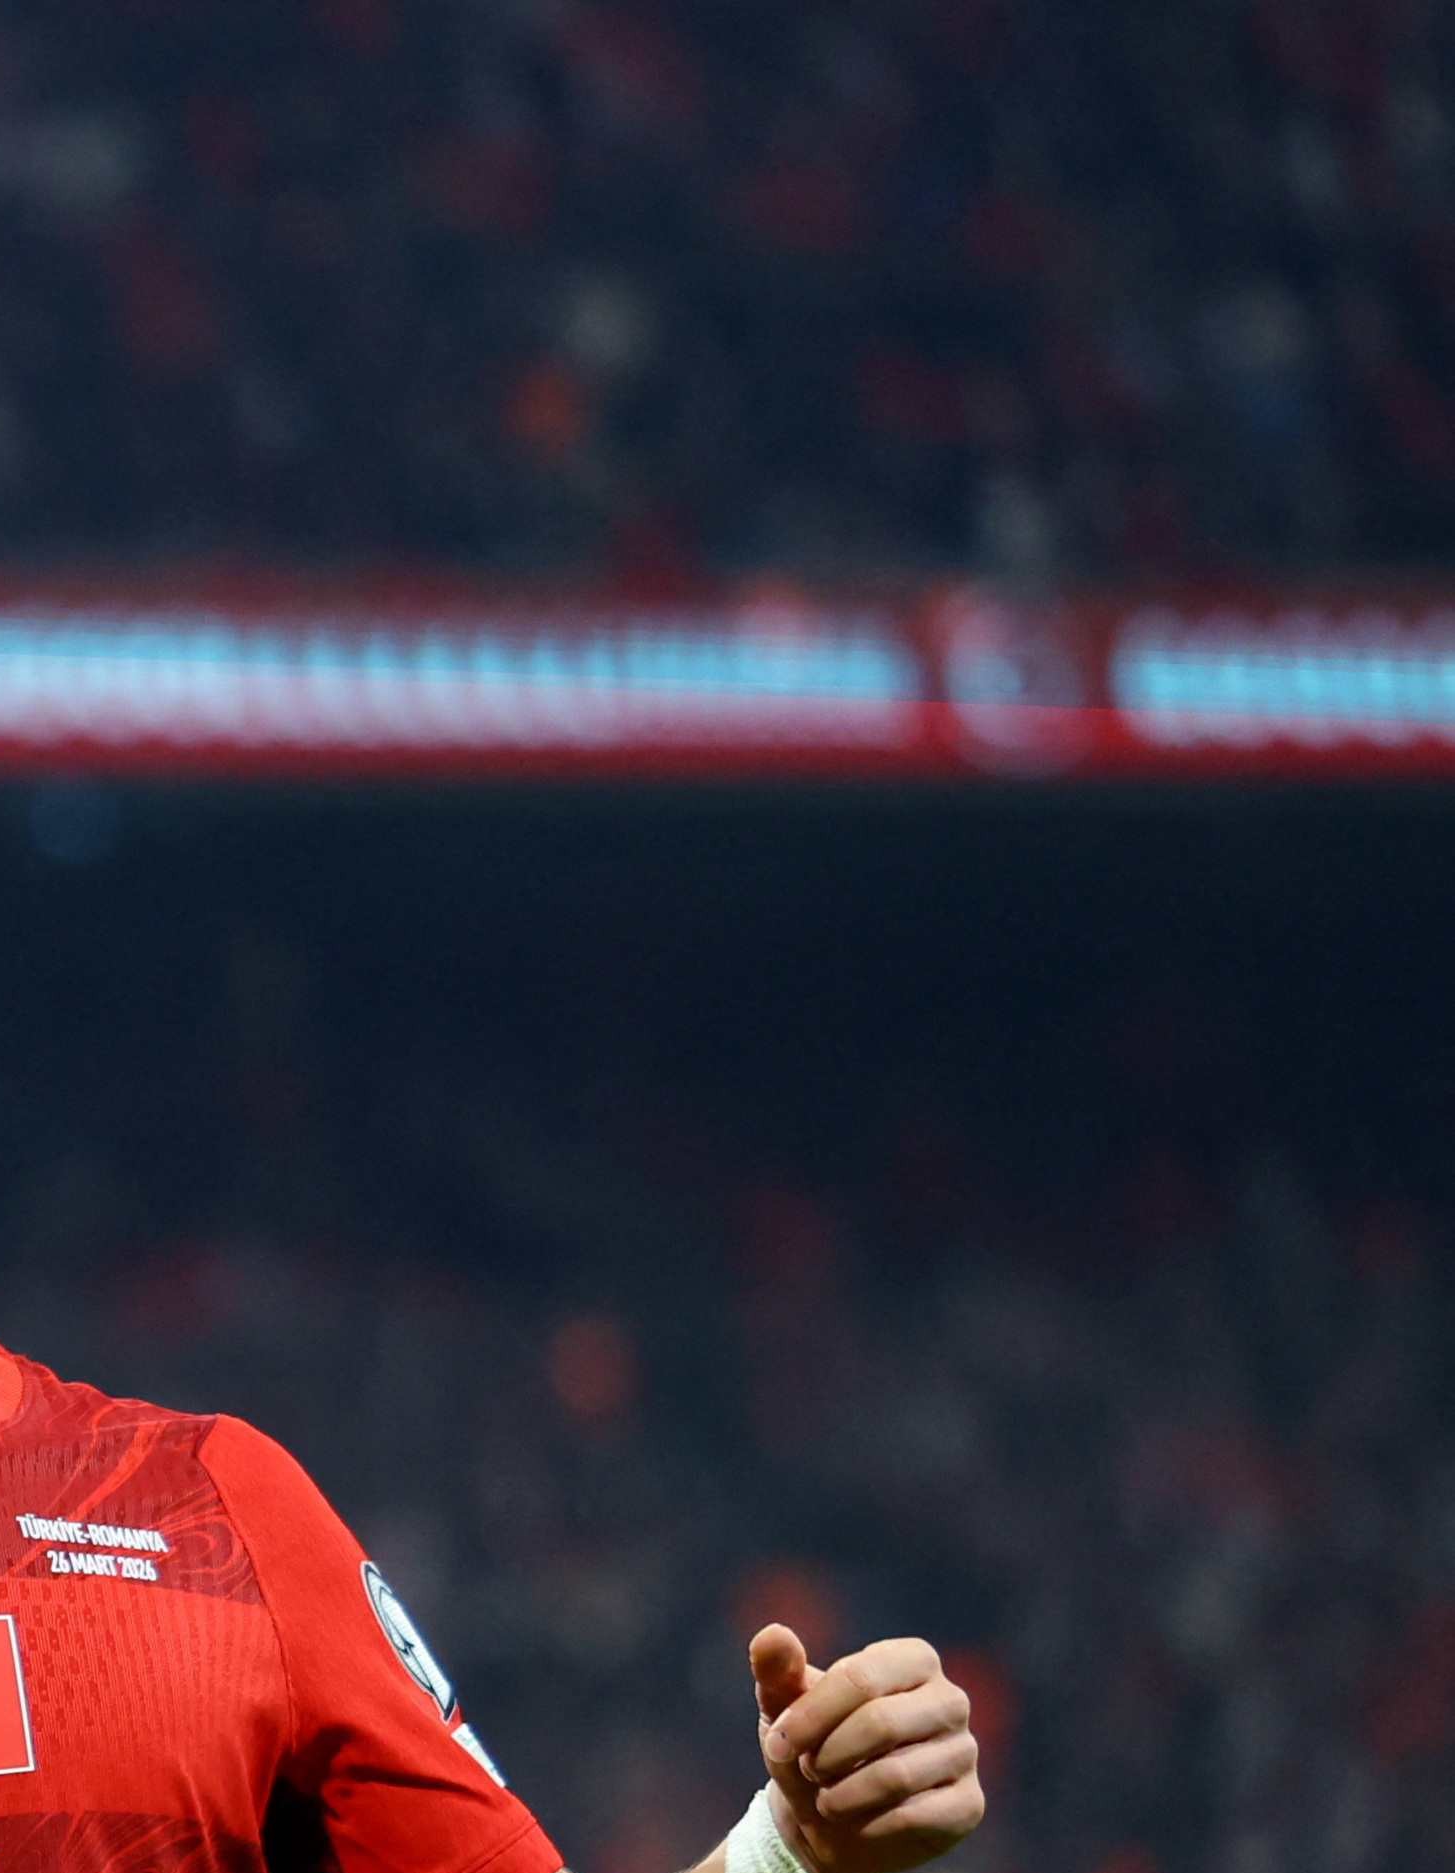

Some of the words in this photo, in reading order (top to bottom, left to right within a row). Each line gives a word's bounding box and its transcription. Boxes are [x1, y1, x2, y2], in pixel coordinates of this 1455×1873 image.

[16, 1513, 170, 1553] TÜRKİYE-ROMANYA
[47, 1550, 70, 1574] 26
[69, 1551, 118, 1577] MART
[117, 1556, 158, 1582] 2026
